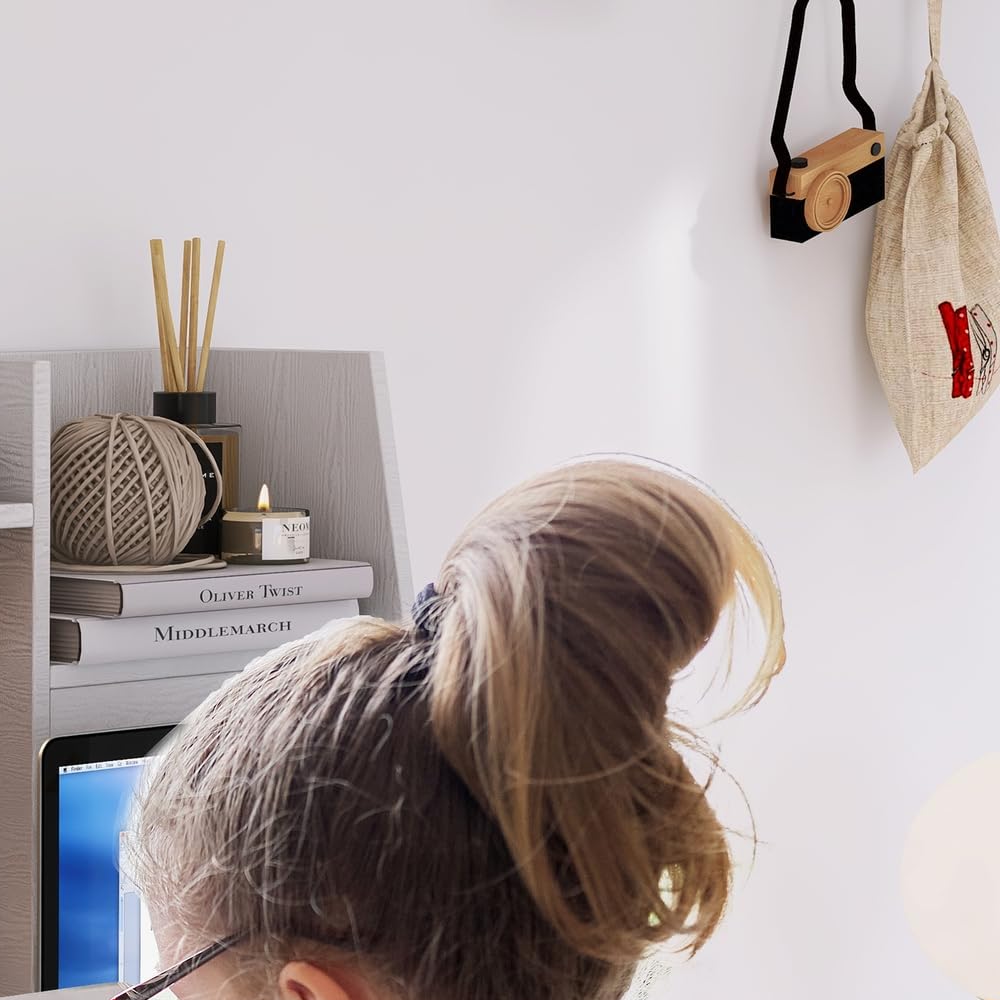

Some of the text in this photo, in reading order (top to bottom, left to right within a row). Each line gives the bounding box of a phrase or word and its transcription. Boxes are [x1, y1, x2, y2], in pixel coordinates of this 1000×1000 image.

[199, 582, 303, 604] OLIVER TWIST
[154, 620, 292, 643] MIDDLEMARCH
